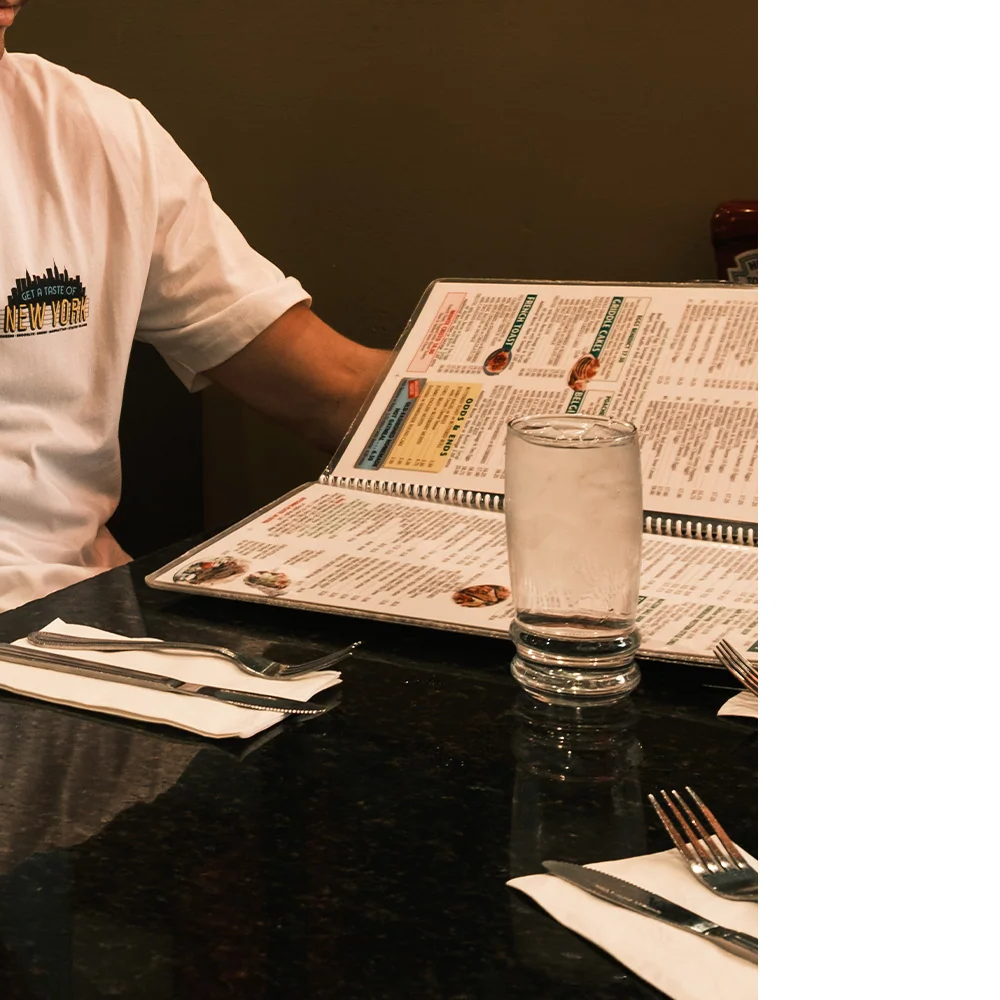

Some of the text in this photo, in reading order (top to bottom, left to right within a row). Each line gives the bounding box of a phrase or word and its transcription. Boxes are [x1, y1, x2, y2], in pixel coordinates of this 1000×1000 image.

[21, 285, 77, 301] GET A TASTE OF
[3, 294, 87, 333] NEW YORK
[505, 297, 535, 346] FRENCH TOAST
[602, 299, 622, 328] GRIDDLE
[592, 329, 607, 352] CAKES
[457, 398, 474, 421] ODDS
[568, 391, 583, 413] BELGI
[440, 434, 456, 457] ENDS
